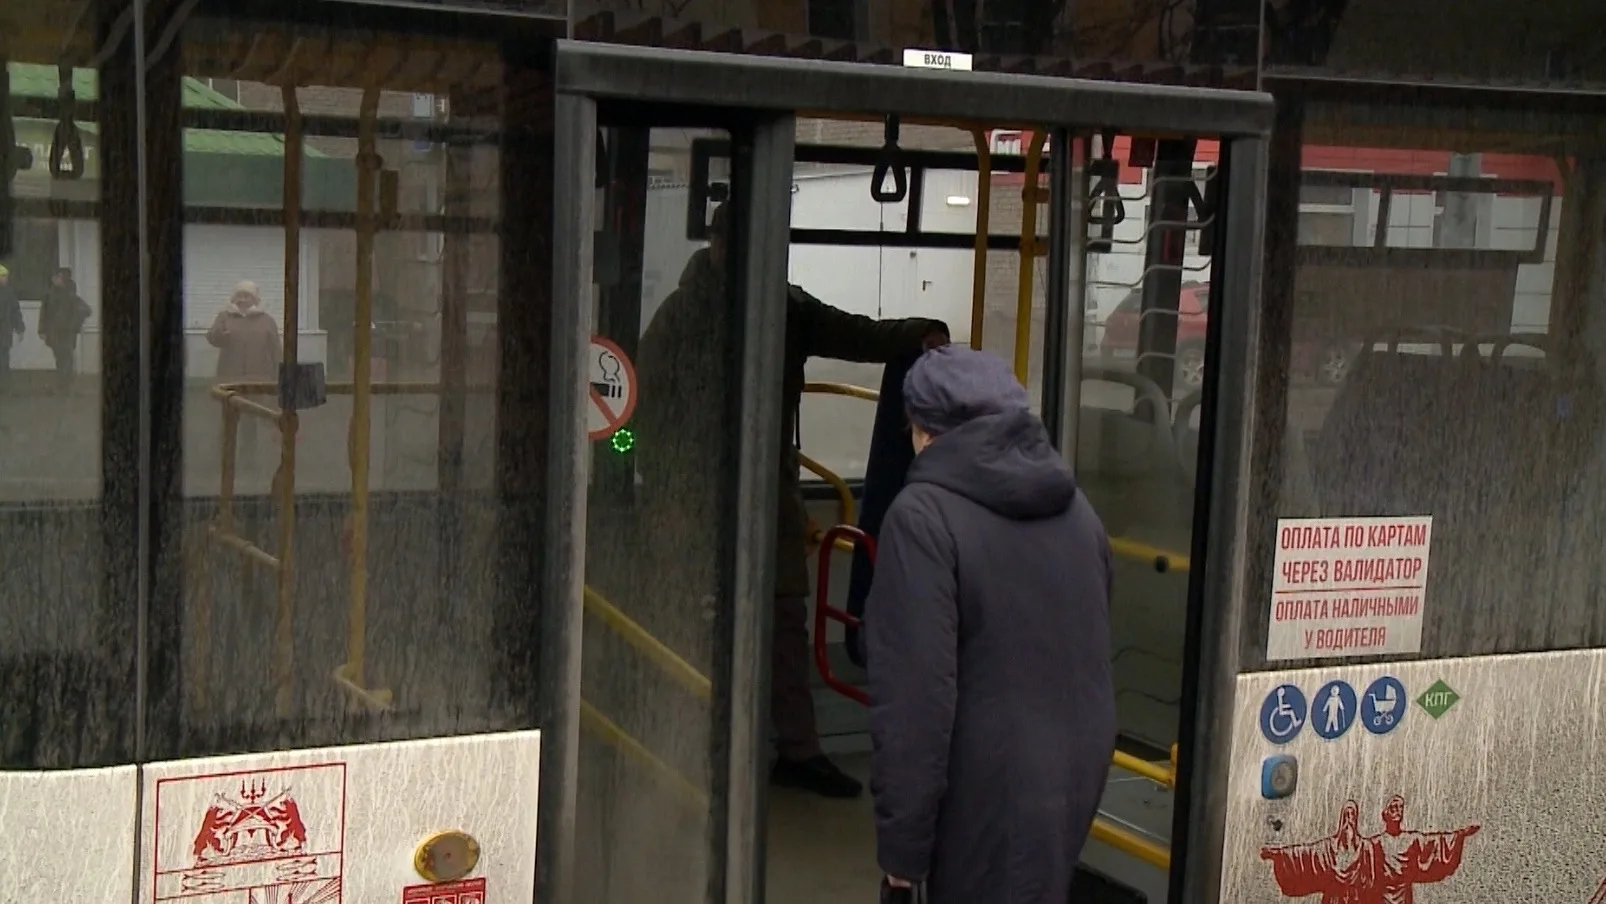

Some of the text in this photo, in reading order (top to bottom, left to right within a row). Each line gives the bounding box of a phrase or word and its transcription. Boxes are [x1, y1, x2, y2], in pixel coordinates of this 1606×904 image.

[924, 54, 951, 66] ВХОД
[1281, 524, 1427, 550] ОПЛАТА ПО КАРТАМ
[1283, 558, 1422, 584] ЧЕРЕЗ ВАЛИДАТОР
[1275, 596, 1419, 622] ОПЛАТА НАЛИЧНЫМИ
[1305, 626, 1386, 651] У ВОДИТЕЛЯ
[1425, 692, 1453, 707] КПГ
